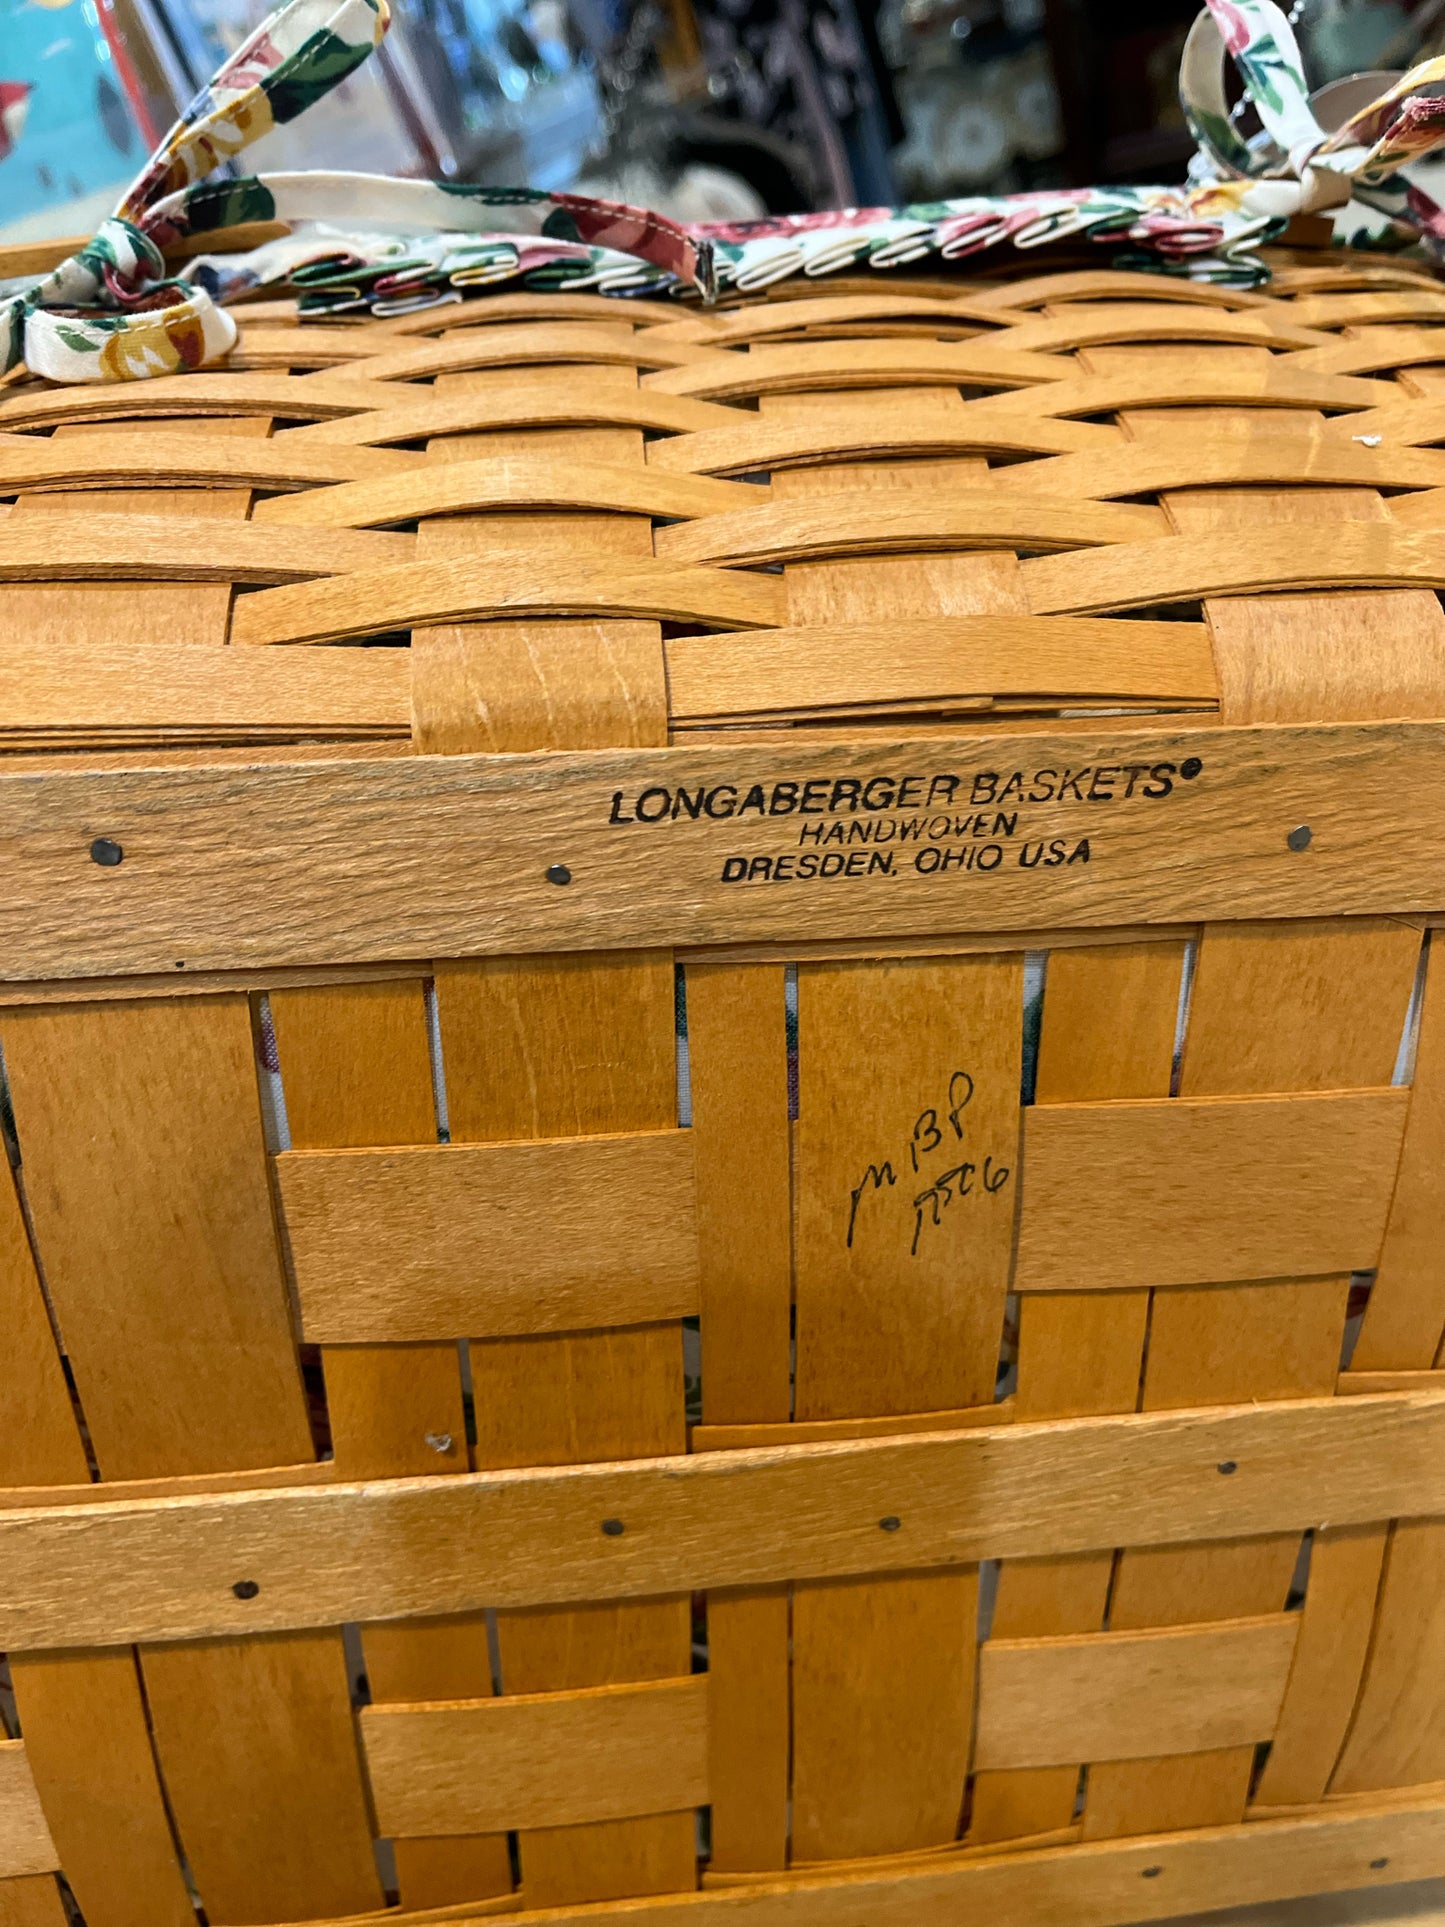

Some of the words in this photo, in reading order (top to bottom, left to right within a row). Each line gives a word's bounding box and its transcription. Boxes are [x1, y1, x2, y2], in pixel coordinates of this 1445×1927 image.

[608, 775, 959, 825] LONGABERGER
[799, 811, 1020, 846] HANDWOVEN
[721, 846, 899, 883] DRESDEN,
[914, 844, 1004, 875] OHIO
[1018, 838, 1092, 868] USA
